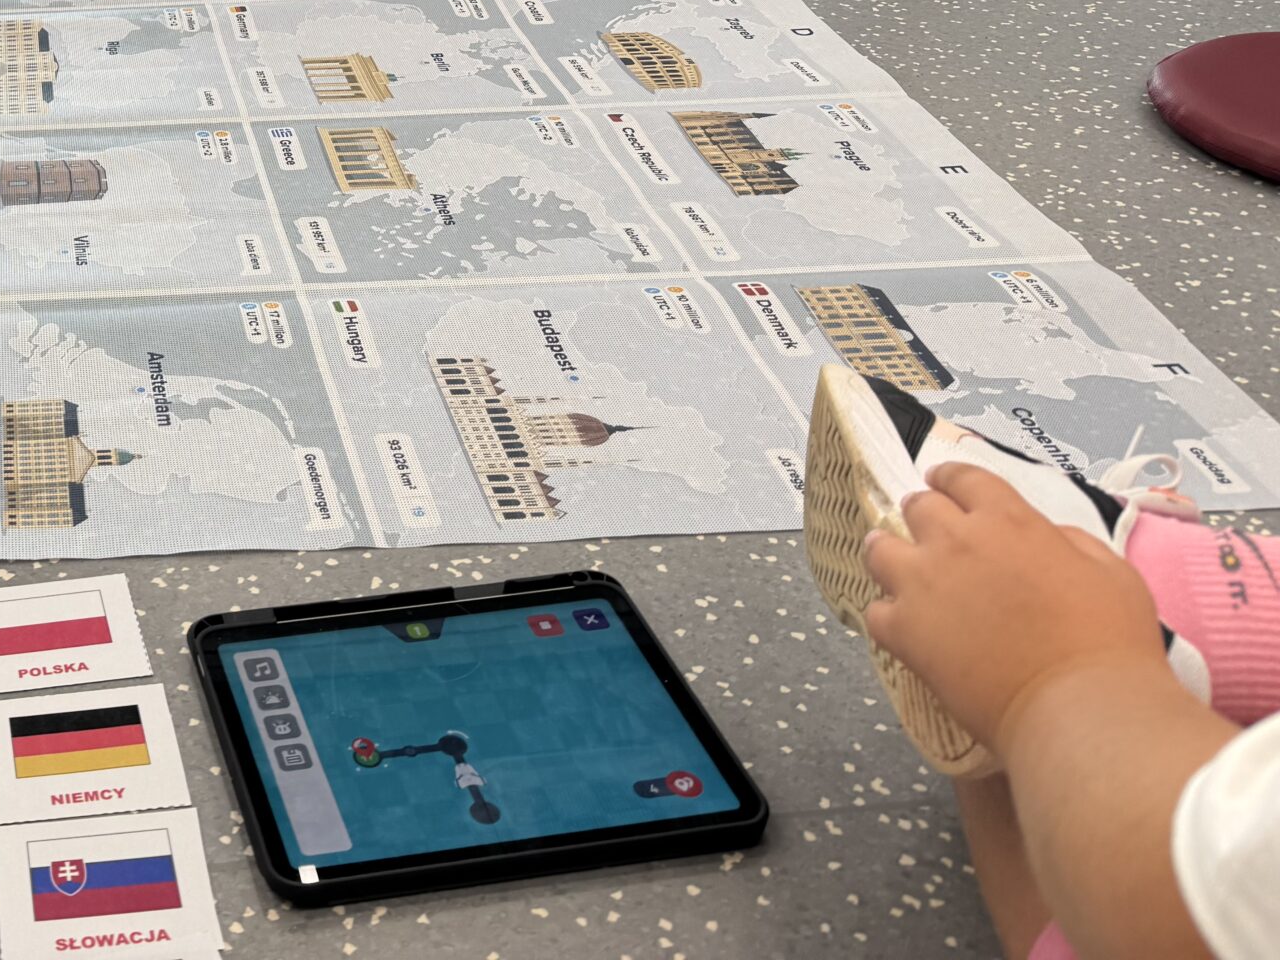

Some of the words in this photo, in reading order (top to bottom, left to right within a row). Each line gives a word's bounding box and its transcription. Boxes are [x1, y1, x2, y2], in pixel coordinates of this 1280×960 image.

[524, 0, 544, 21] Croatia
[235, 13, 249, 39] Germany
[725, 17, 754, 39] Zagreb
[105, 40, 120, 55] Riga
[430, 52, 450, 71] Berlin
[279, 139, 295, 165] Greece
[621, 126, 644, 150] Czech
[637, 151, 668, 181] Republic
[834, 140, 870, 171] Prague
[430, 193, 455, 225] Athens
[73, 234, 90, 266] Vilnius
[1002, 279, 1024, 294] UTC
[1031, 283, 1058, 308] million
[652, 294, 670, 310] UTC
[245, 310, 259, 326] UTC
[682, 303, 702, 329] million
[756, 299, 797, 348] Denmark
[271, 318, 285, 344] million
[343, 316, 366, 362] Hungary
[533, 309, 575, 371] Budapest
[1152, 362, 1190, 374] F
[147, 351, 171, 426] Amsterdam
[387, 439, 402, 451] 93
[1012, 407, 1083, 480] Copenha
[392, 452, 409, 470] 026
[1189, 446, 1231, 484] Goddag
[304, 453, 330, 519] Goedemorgen
[17, 661, 90, 679] POLSKA
[50, 787, 127, 806] NIEMCY
[55, 928, 173, 952] SŁOWACJA
